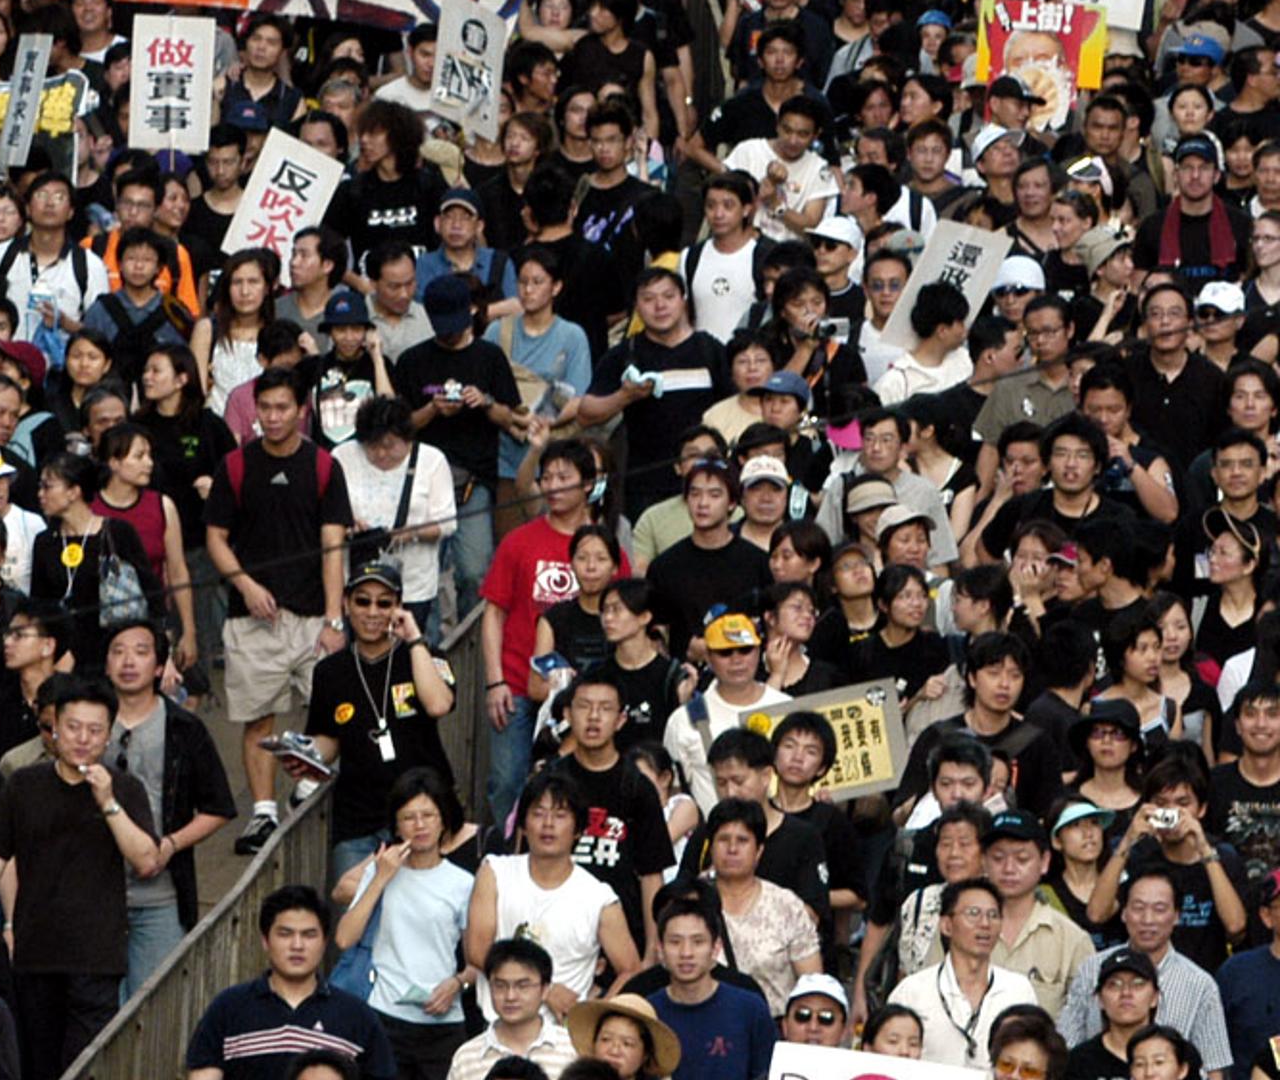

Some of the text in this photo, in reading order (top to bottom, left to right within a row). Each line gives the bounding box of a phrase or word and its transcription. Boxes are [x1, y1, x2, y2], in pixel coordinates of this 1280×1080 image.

[1013, 0, 1074, 34] 上街!
[145, 38, 195, 133] 做實事
[246, 159, 318, 258] 反吹水
